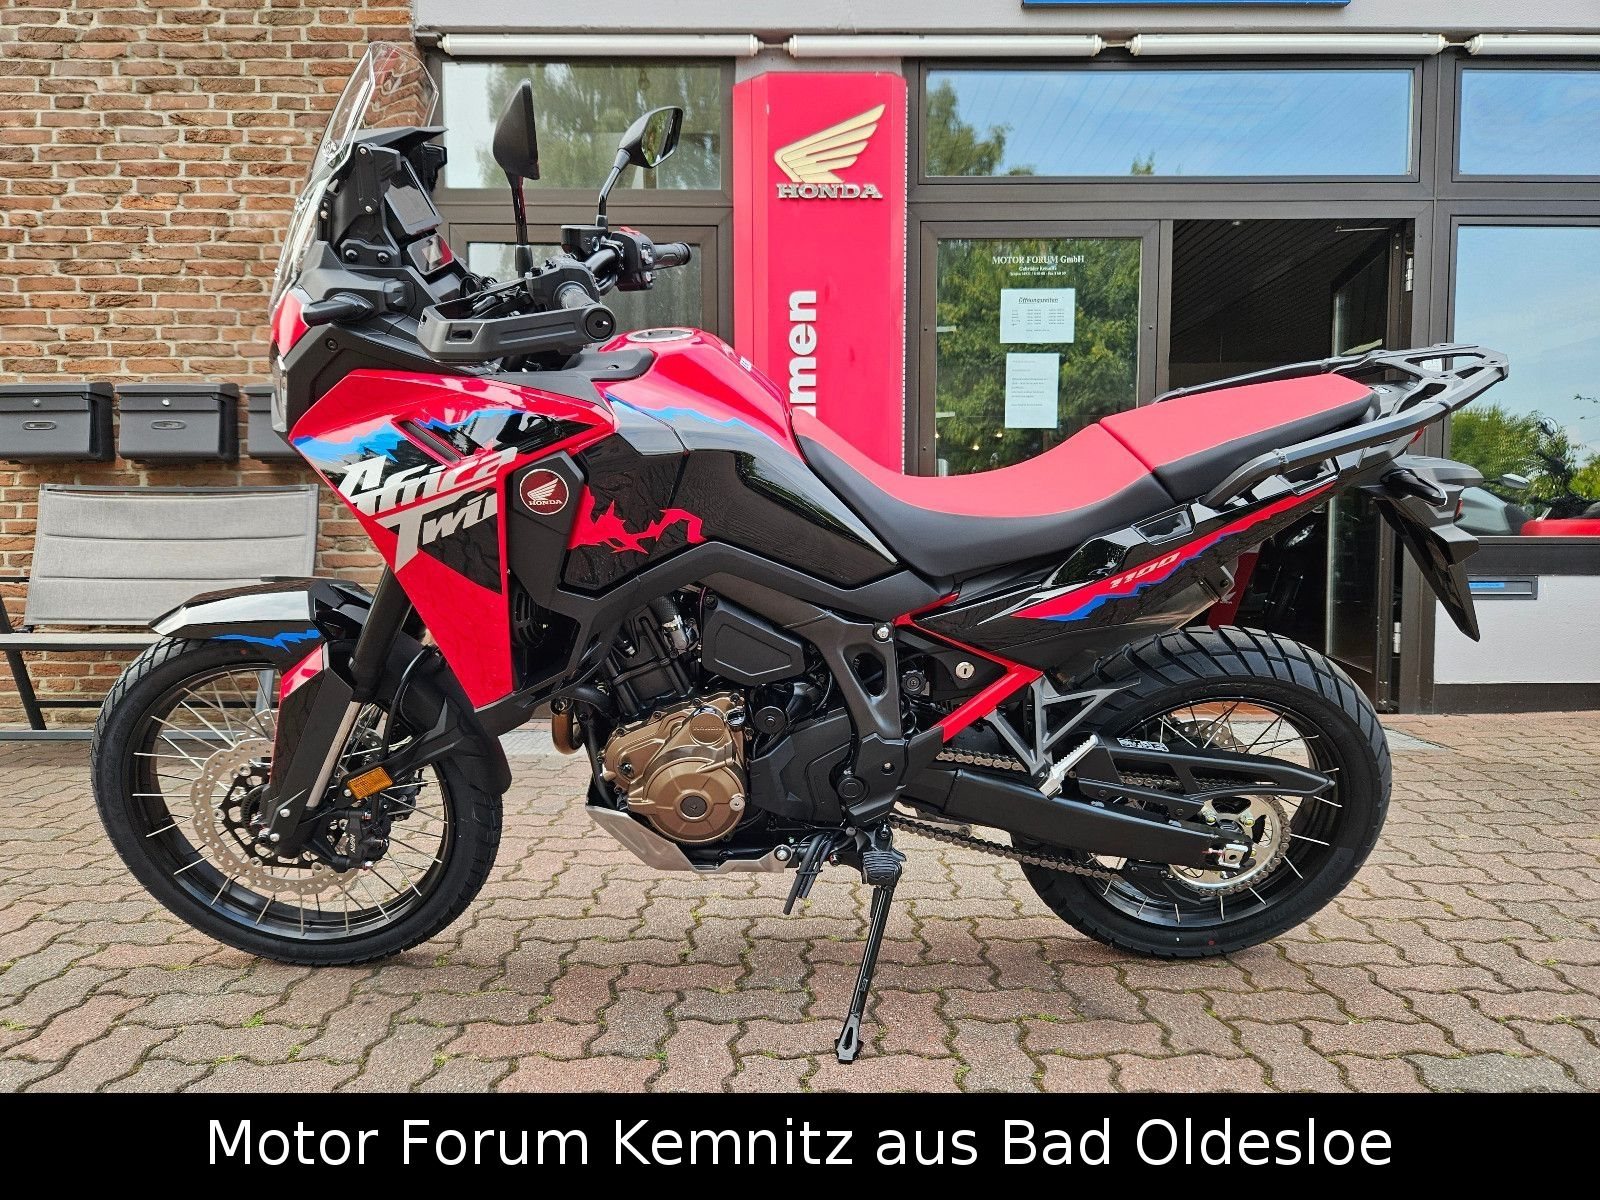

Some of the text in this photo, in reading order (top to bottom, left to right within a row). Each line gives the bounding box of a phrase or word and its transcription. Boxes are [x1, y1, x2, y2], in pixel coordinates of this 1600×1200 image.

[776, 183, 883, 199] HONDA
[992, 255, 1085, 265] MOTOR FORUM GmbH
[337, 447, 518, 517] Africa
[1110, 551, 1181, 589] 1100
